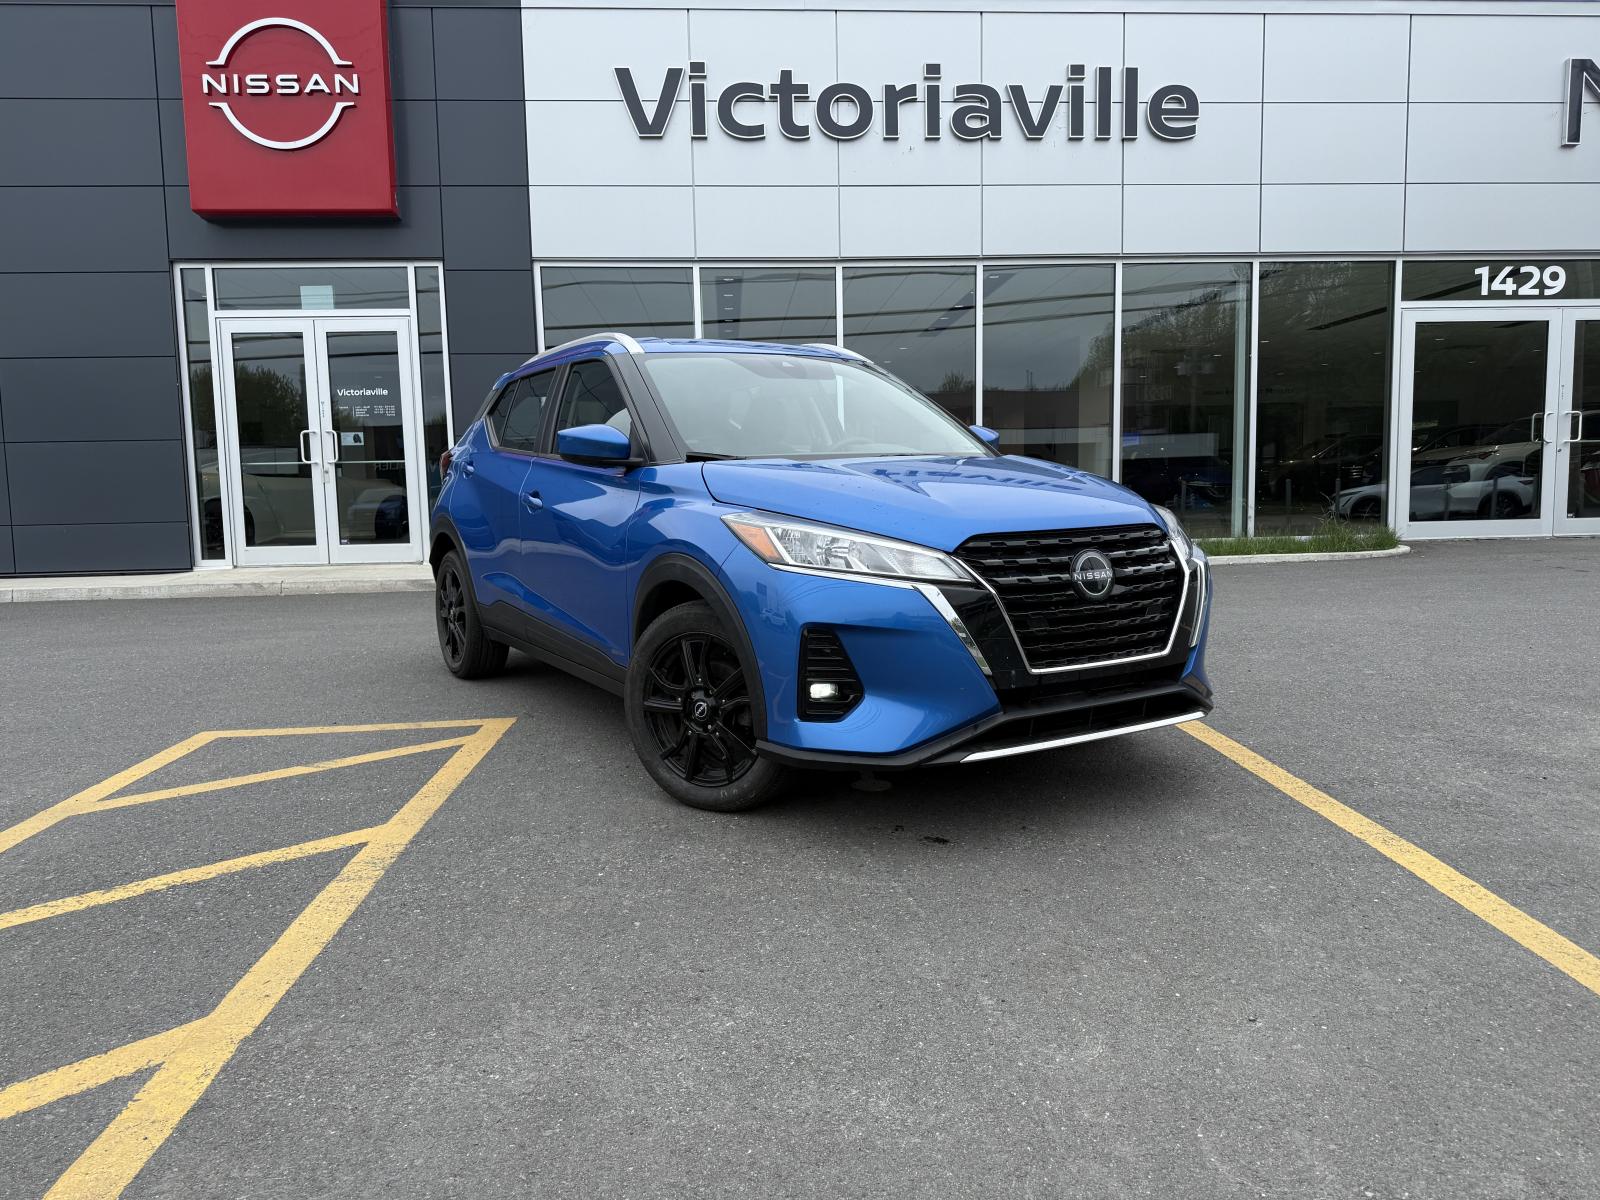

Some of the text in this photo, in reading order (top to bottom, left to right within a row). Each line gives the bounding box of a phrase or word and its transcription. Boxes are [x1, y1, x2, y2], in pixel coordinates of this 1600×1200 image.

[201, 73, 360, 95] NISSAN
[613, 61, 1200, 140] Victoriaville
[1474, 265, 1567, 296] 1429
[337, 387, 388, 396] Victoriaville
[1074, 570, 1113, 581] NISSAN
